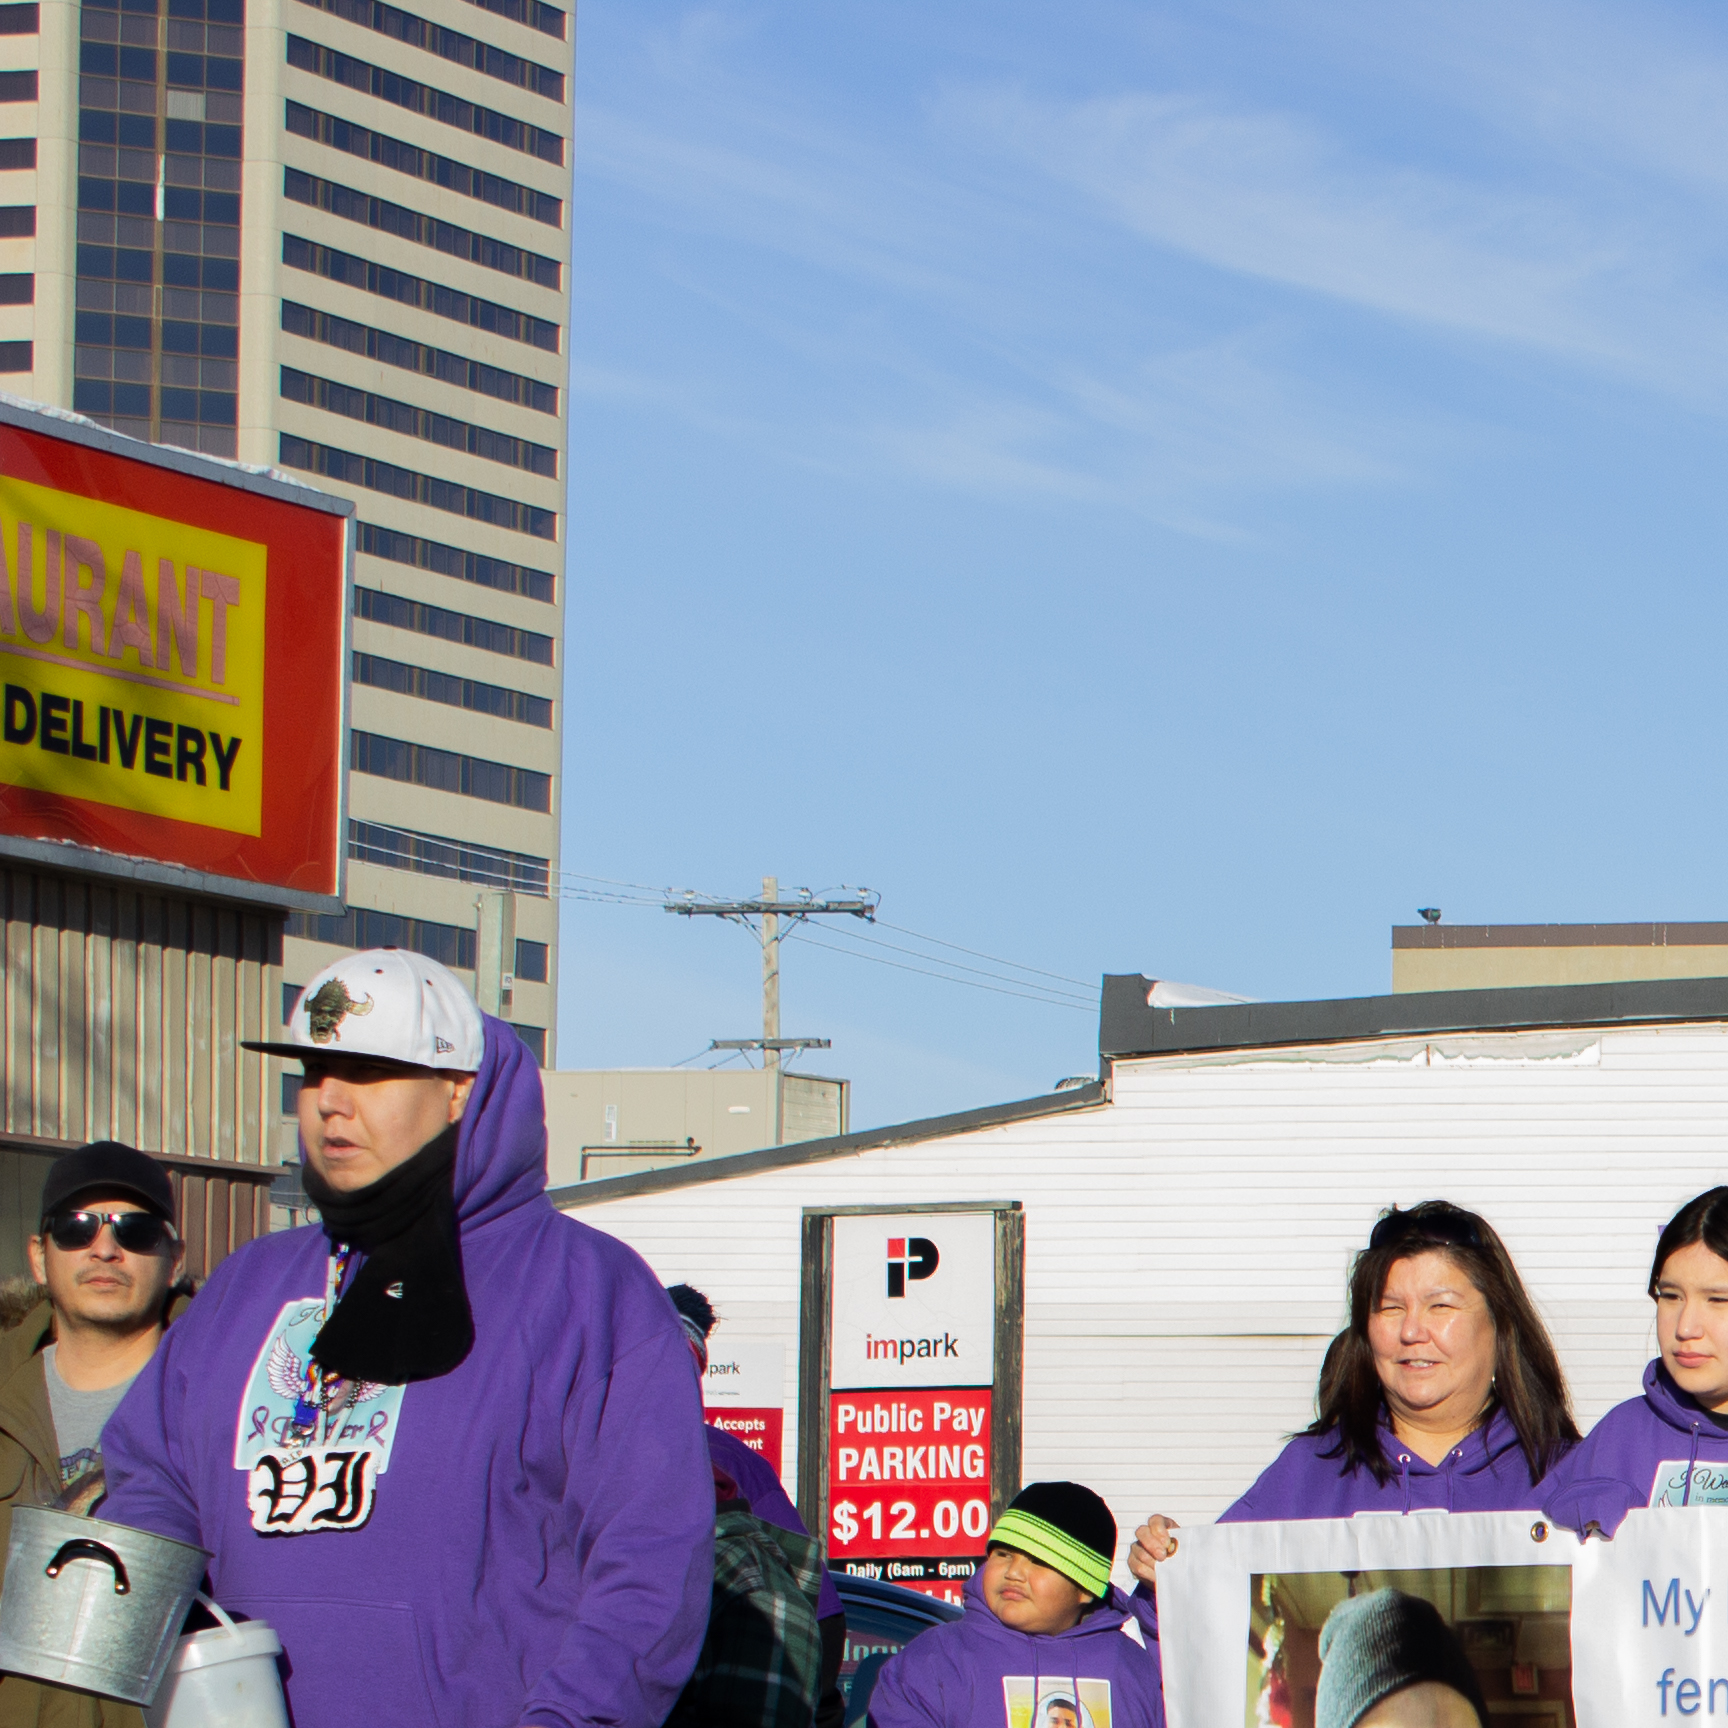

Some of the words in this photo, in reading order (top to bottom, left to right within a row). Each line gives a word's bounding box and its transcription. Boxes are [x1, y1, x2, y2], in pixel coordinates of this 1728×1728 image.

[4, 683, 242, 792] DELIVERY
[866, 1332, 958, 1365] impark
[706, 1361, 741, 1378] park
[714, 1417, 766, 1434] Accepts
[837, 1403, 923, 1434] Public
[933, 1402, 985, 1437] Pay
[837, 1443, 986, 1482] PARKING
[832, 1499, 988, 1545] $12.00
[845, 1563, 883, 1581] Daily
[887, 1562, 924, 1579] (6am
[938, 1561, 976, 1579] 6pm)
[1640, 1577, 1703, 1635] My
